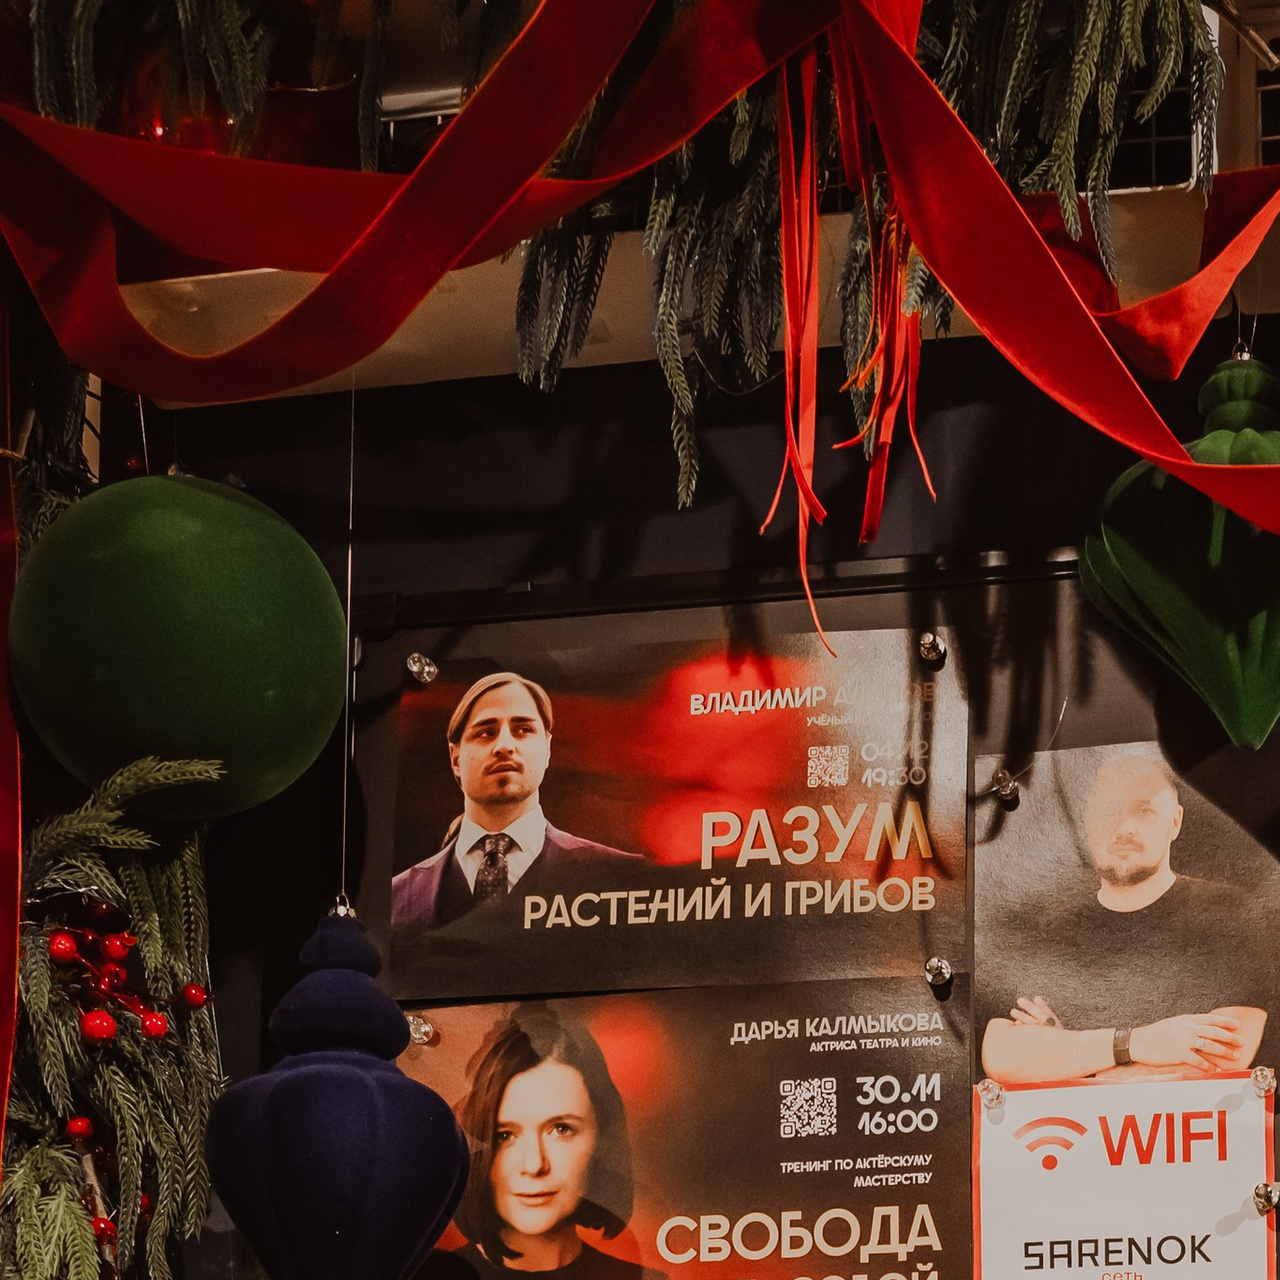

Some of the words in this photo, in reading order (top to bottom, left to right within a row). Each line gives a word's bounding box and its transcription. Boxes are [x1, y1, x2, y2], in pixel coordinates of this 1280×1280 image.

[690, 685, 827, 716] ВЛАДИМИР
[860, 766, 927, 788] 19:30
[700, 801, 933, 872] РАЗУМ
[524, 878, 732, 930] РАСТЕНИЙ
[744, 883, 772, 919] И
[785, 877, 936, 916] ГРИБОВ
[730, 1019, 799, 1046] ДАРЬЯ
[805, 1012, 944, 1038] КАЛМЫКОВА
[809, 1040, 858, 1053] АКТРИСА
[859, 1037, 899, 1050] ТЕАТРА
[901, 1037, 910, 1048] И
[911, 1036, 942, 1047] КИНО
[856, 1073, 941, 1105] 30.11
[858, 1108, 939, 1136] 16:00
[1098, 1109, 1228, 1167] WIFI
[780, 1159, 833, 1174] ТРЕНИНГ
[834, 1158, 854, 1171] ПО
[855, 1153, 933, 1170] АКТЁРСКУМУ
[853, 1172, 933, 1188] МАСТЕРСТВУ
[656, 1204, 942, 1265] СВОБОДА
[1023, 1233, 1213, 1270] SARENOK
